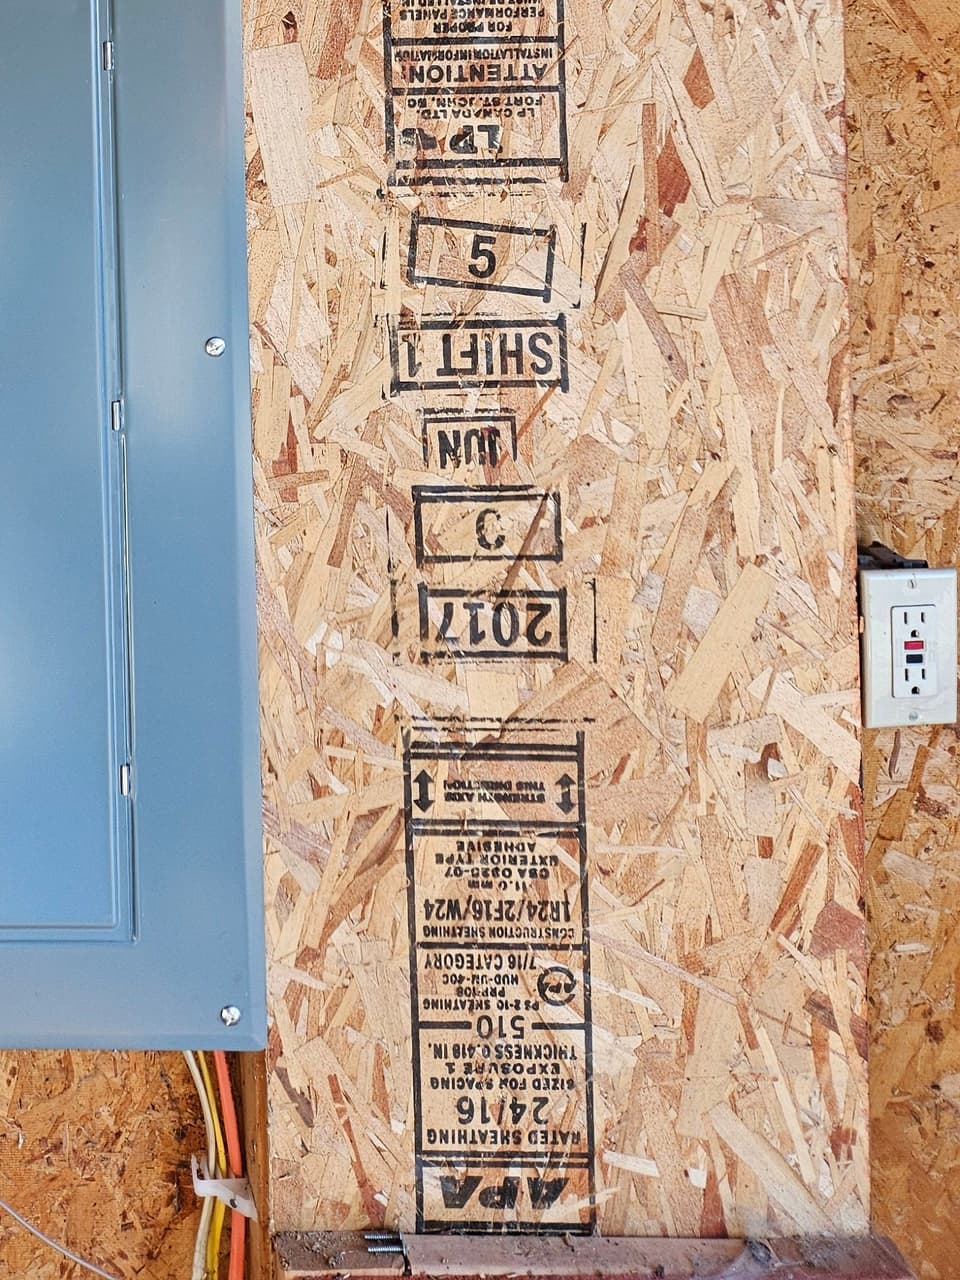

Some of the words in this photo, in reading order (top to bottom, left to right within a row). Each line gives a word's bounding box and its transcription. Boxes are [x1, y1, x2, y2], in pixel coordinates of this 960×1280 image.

[399, 8, 447, 21] PANELS
[450, 6, 545, 19] PERFORMANCE
[433, 22, 484, 34] PROPER
[488, 21, 512, 33] FOR
[394, 49, 472, 62] INFORMATION
[473, 48, 553, 59] INSTALLATION
[400, 64, 548, 84] ATTENTION:
[507, 96, 543, 106] FORT
[416, 109, 448, 119] LTD.
[451, 108, 513, 118] CANADA
[517, 107, 535, 117] LP
[449, 124, 501, 155] LP
[468, 233, 497, 279] 5
[402, 333, 422, 378] 1
[436, 332, 554, 377] SHIFT
[438, 428, 501, 469] JUN
[475, 508, 506, 551] C
[435, 601, 553, 648] 2017
[456, 840, 536, 853] ADHESIVE
[435, 853, 474, 866] TYPE
[479, 853, 559, 867] EXTERIOR
[422, 925, 486, 939] SHEATHING
[489, 926, 575, 940] CONSTRUCTION
[424, 953, 503, 971] CATEGORY
[508, 953, 537, 970] 7/16
[423, 998, 491, 1012] SHEATHING
[476, 1014, 525, 1040] 510
[427, 1043, 448, 1060] IN.
[452, 1043, 491, 1060] 0.418
[494, 1043, 577, 1061] THICKNESS
[444, 1062, 455, 1075] 1
[462, 1060, 560, 1075] EXPOSURE
[430, 1076, 494, 1091] SPACING
[499, 1076, 526, 1091] FOR
[532, 1076, 576, 1091] SIZED
[456, 1095, 549, 1126] 24/16
[426, 1128, 522, 1145] SHEATHING
[527, 1129, 581, 1145] RATED
[438, 1175, 570, 1210] APA
